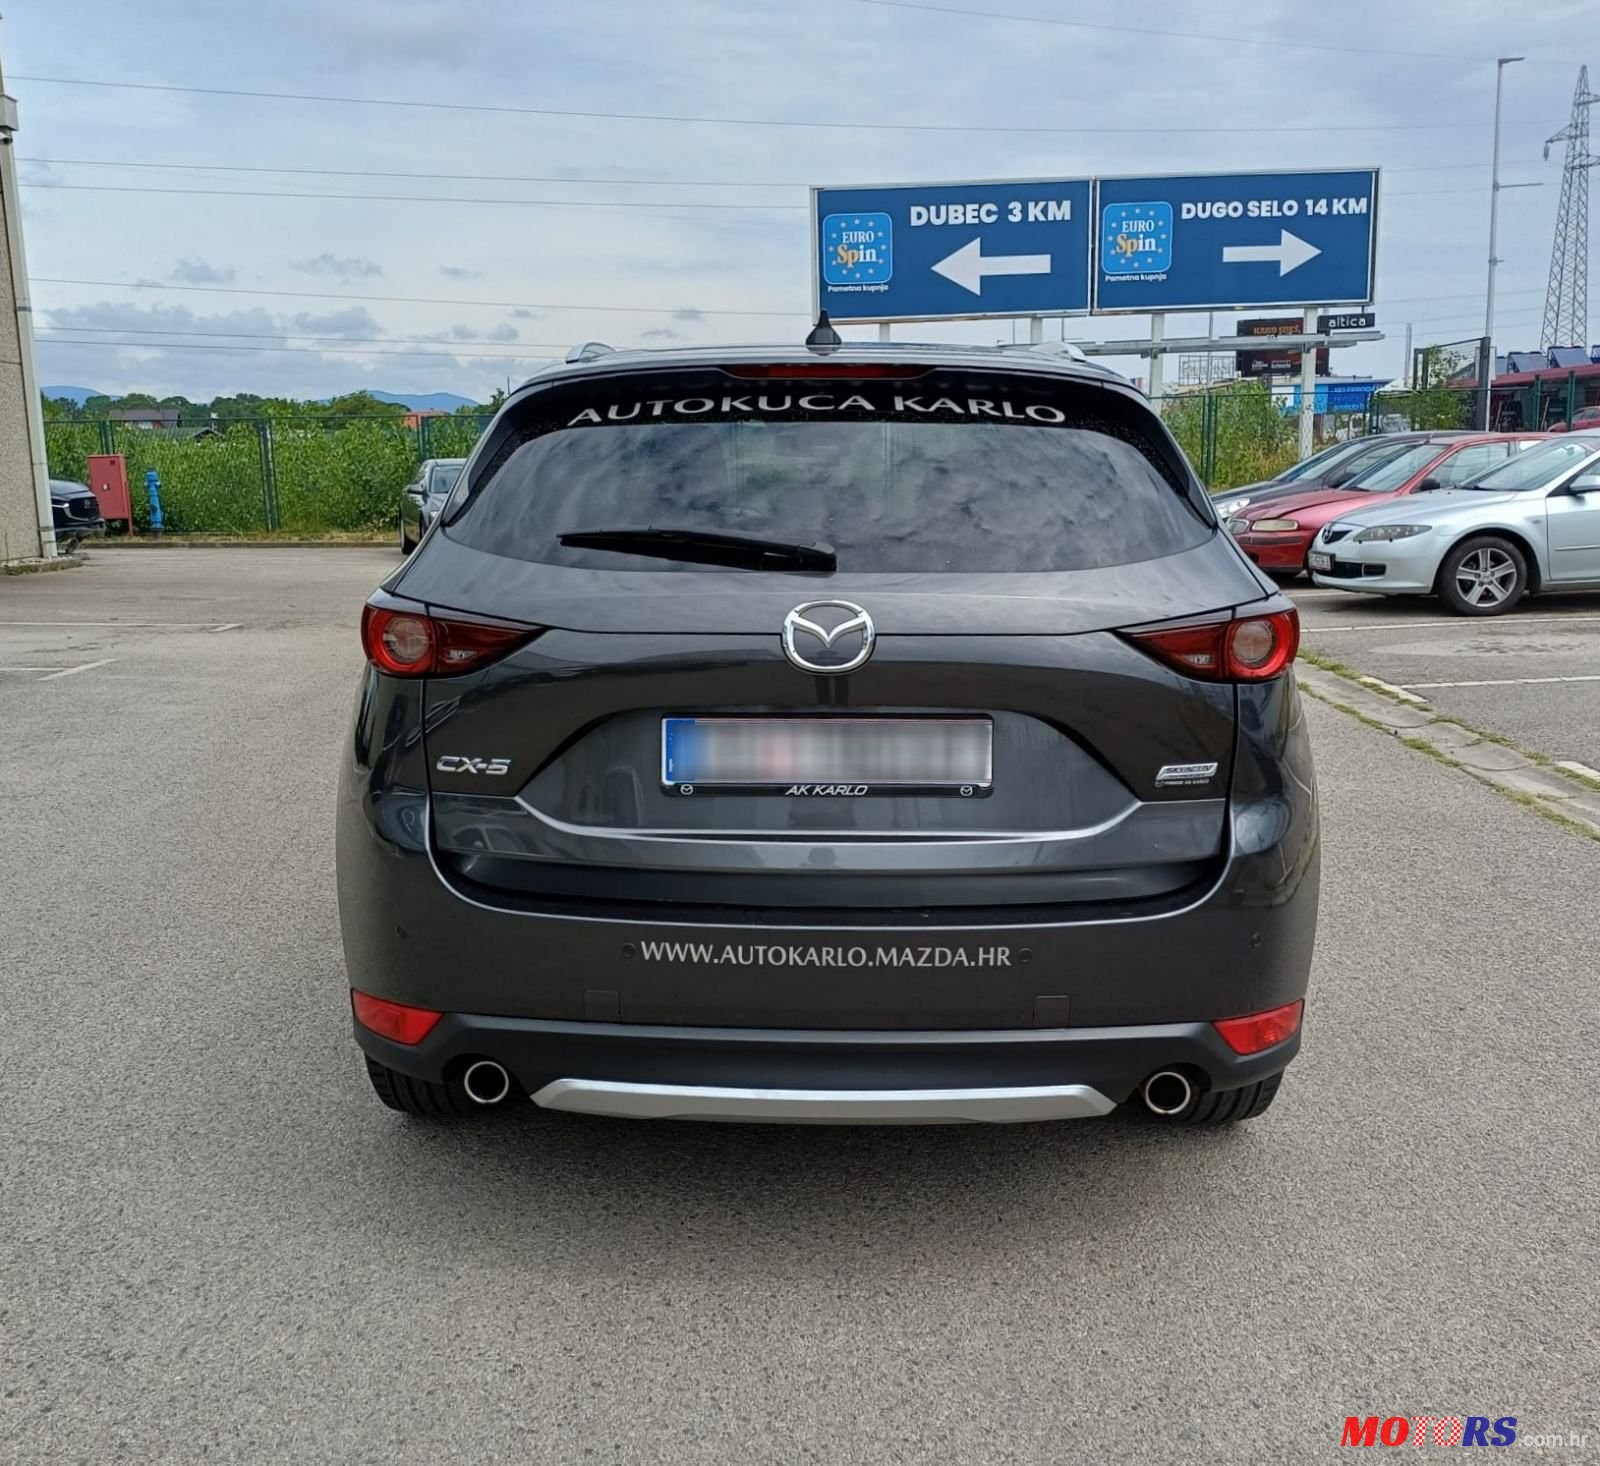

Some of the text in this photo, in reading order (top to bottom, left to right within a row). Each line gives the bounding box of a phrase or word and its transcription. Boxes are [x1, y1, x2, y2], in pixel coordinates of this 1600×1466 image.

[910, 200, 1072, 227] DUBEC 3 KM
[1181, 198, 1367, 219] DUGO SELO 14 KM
[1121, 219, 1155, 233] EURO
[842, 231, 875, 244] EURO
[1115, 233, 1157, 257] Spin
[837, 244, 877, 268] Spin
[1328, 316, 1366, 328] altica
[566, 395, 1066, 428] AUTOKUCA KARLO
[436, 756, 512, 775] CX-5
[785, 785, 868, 796] AK KARLO
[640, 940, 1012, 967] WWW.AUTOKARLO.MAZDA.HR
